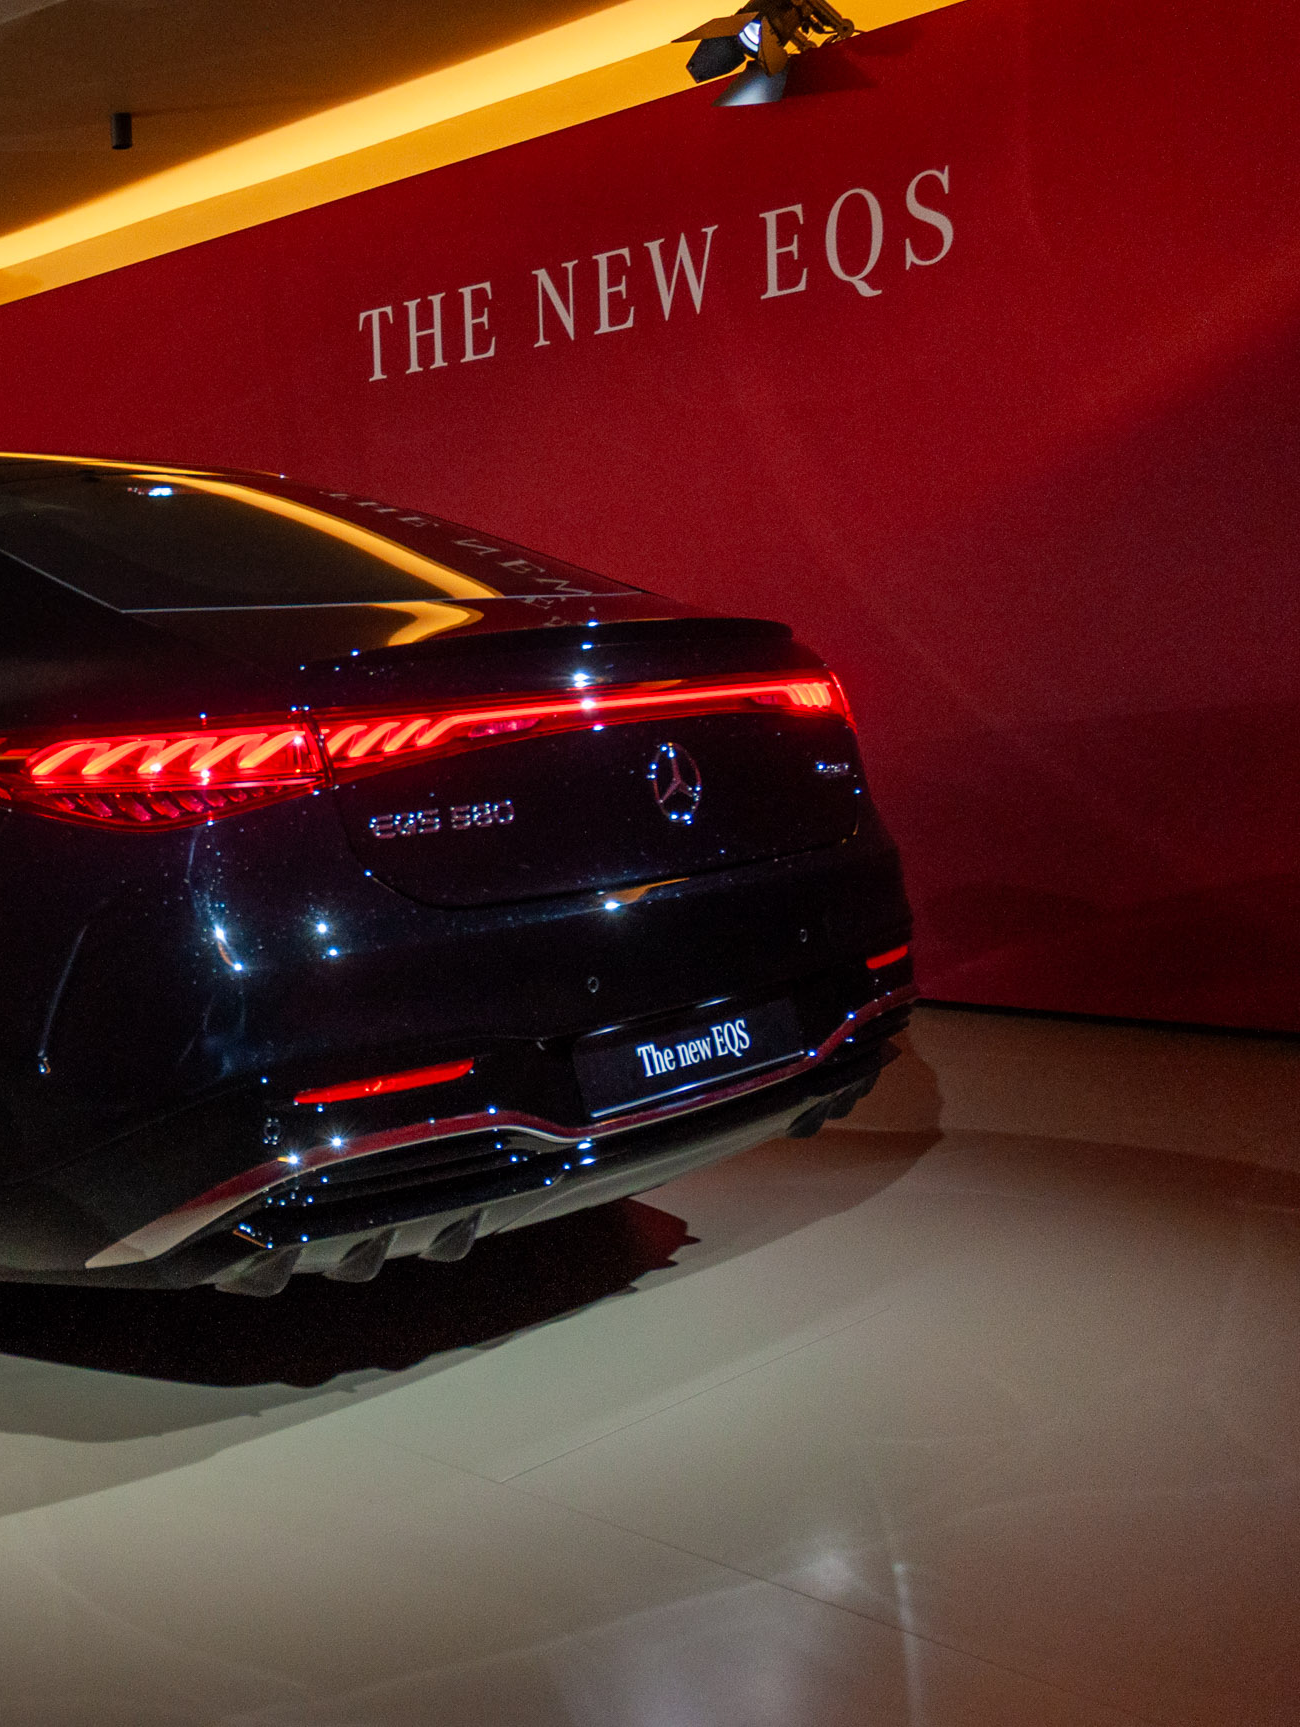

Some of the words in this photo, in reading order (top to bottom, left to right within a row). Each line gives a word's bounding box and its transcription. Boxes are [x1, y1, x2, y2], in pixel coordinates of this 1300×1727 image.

[358, 280, 496, 382] THE
[531, 224, 719, 348] NEW
[757, 164, 955, 299] EQS
[369, 808, 440, 840] EQS
[450, 799, 515, 831] 580
[636, 1043, 676, 1078] The
[676, 1035, 711, 1068] new
[710, 1018, 751, 1057] EQS
